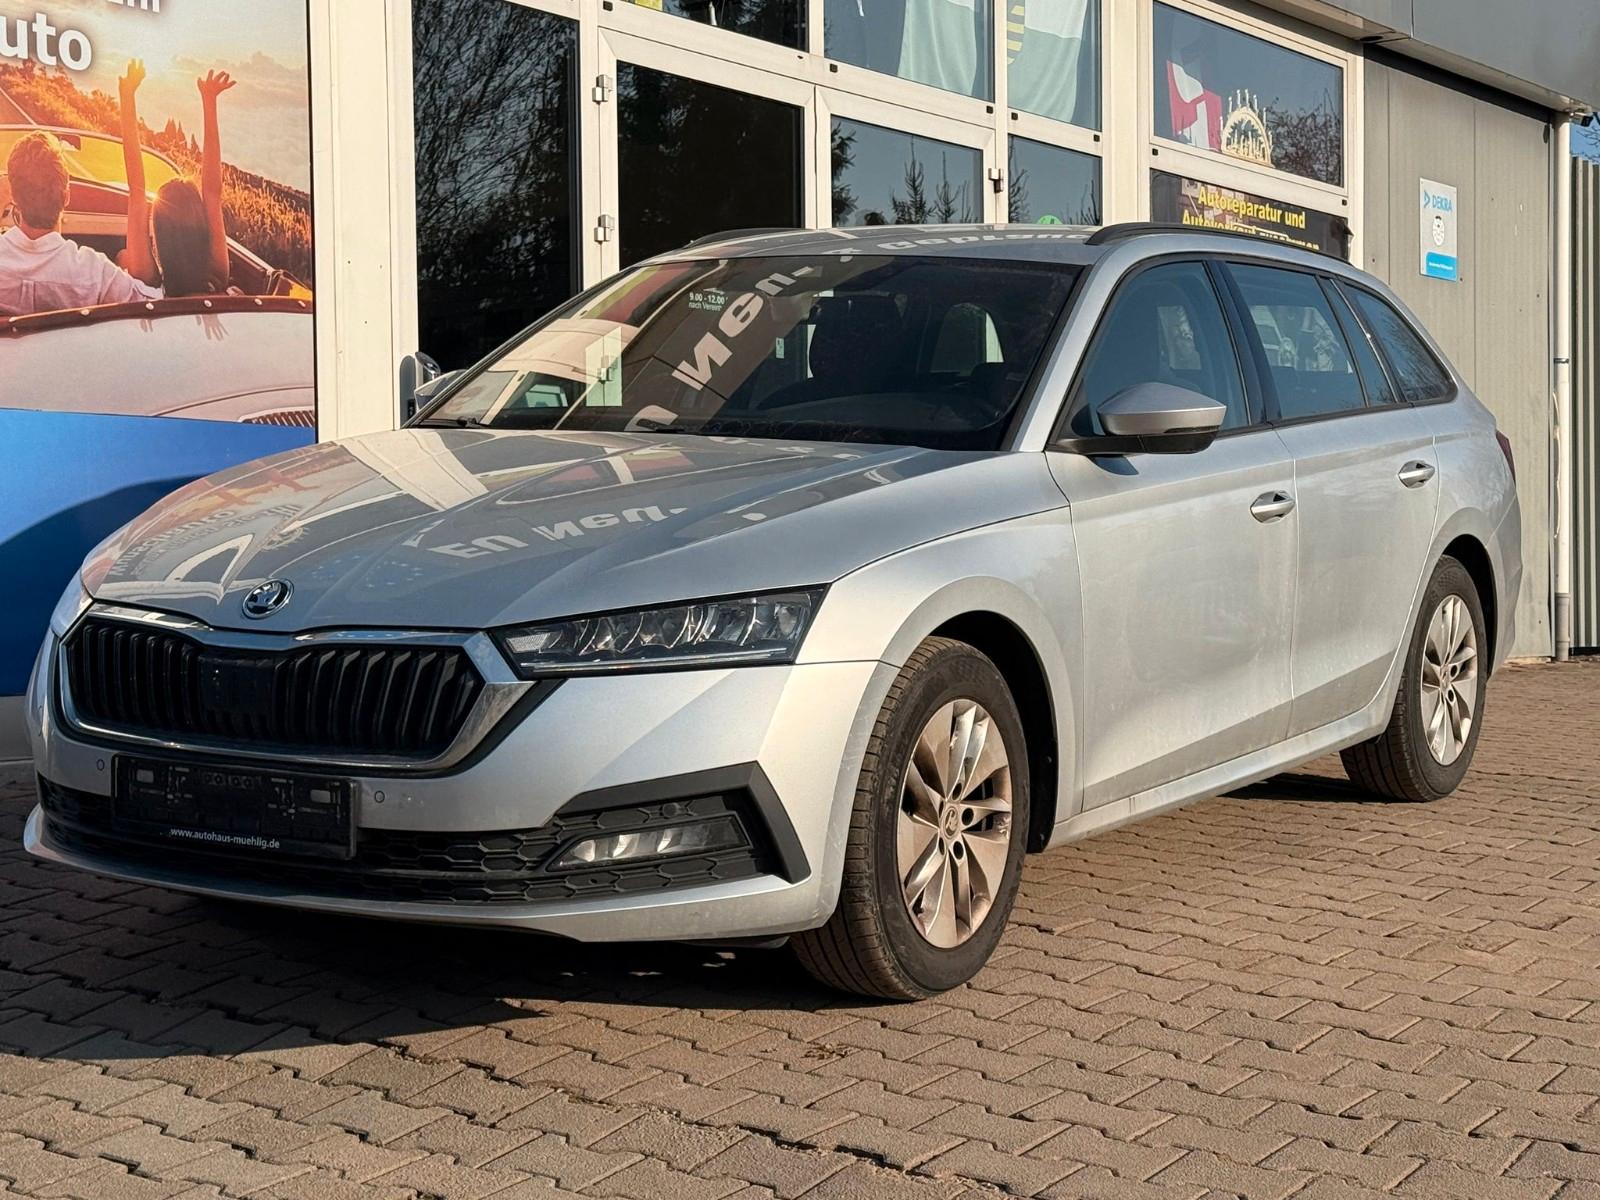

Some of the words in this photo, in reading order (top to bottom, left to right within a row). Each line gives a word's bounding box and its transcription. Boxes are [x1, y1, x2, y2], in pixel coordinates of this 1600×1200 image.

[1198, 186, 1283, 223] Autoreparatur
[1285, 211, 1306, 229] und
[1432, 195, 1453, 212] DEKRA
[689, 292, 703, 301] 9.00
[708, 294, 725, 304] 12.00
[170, 828, 280, 849] www.autohaus-muehlig.de
